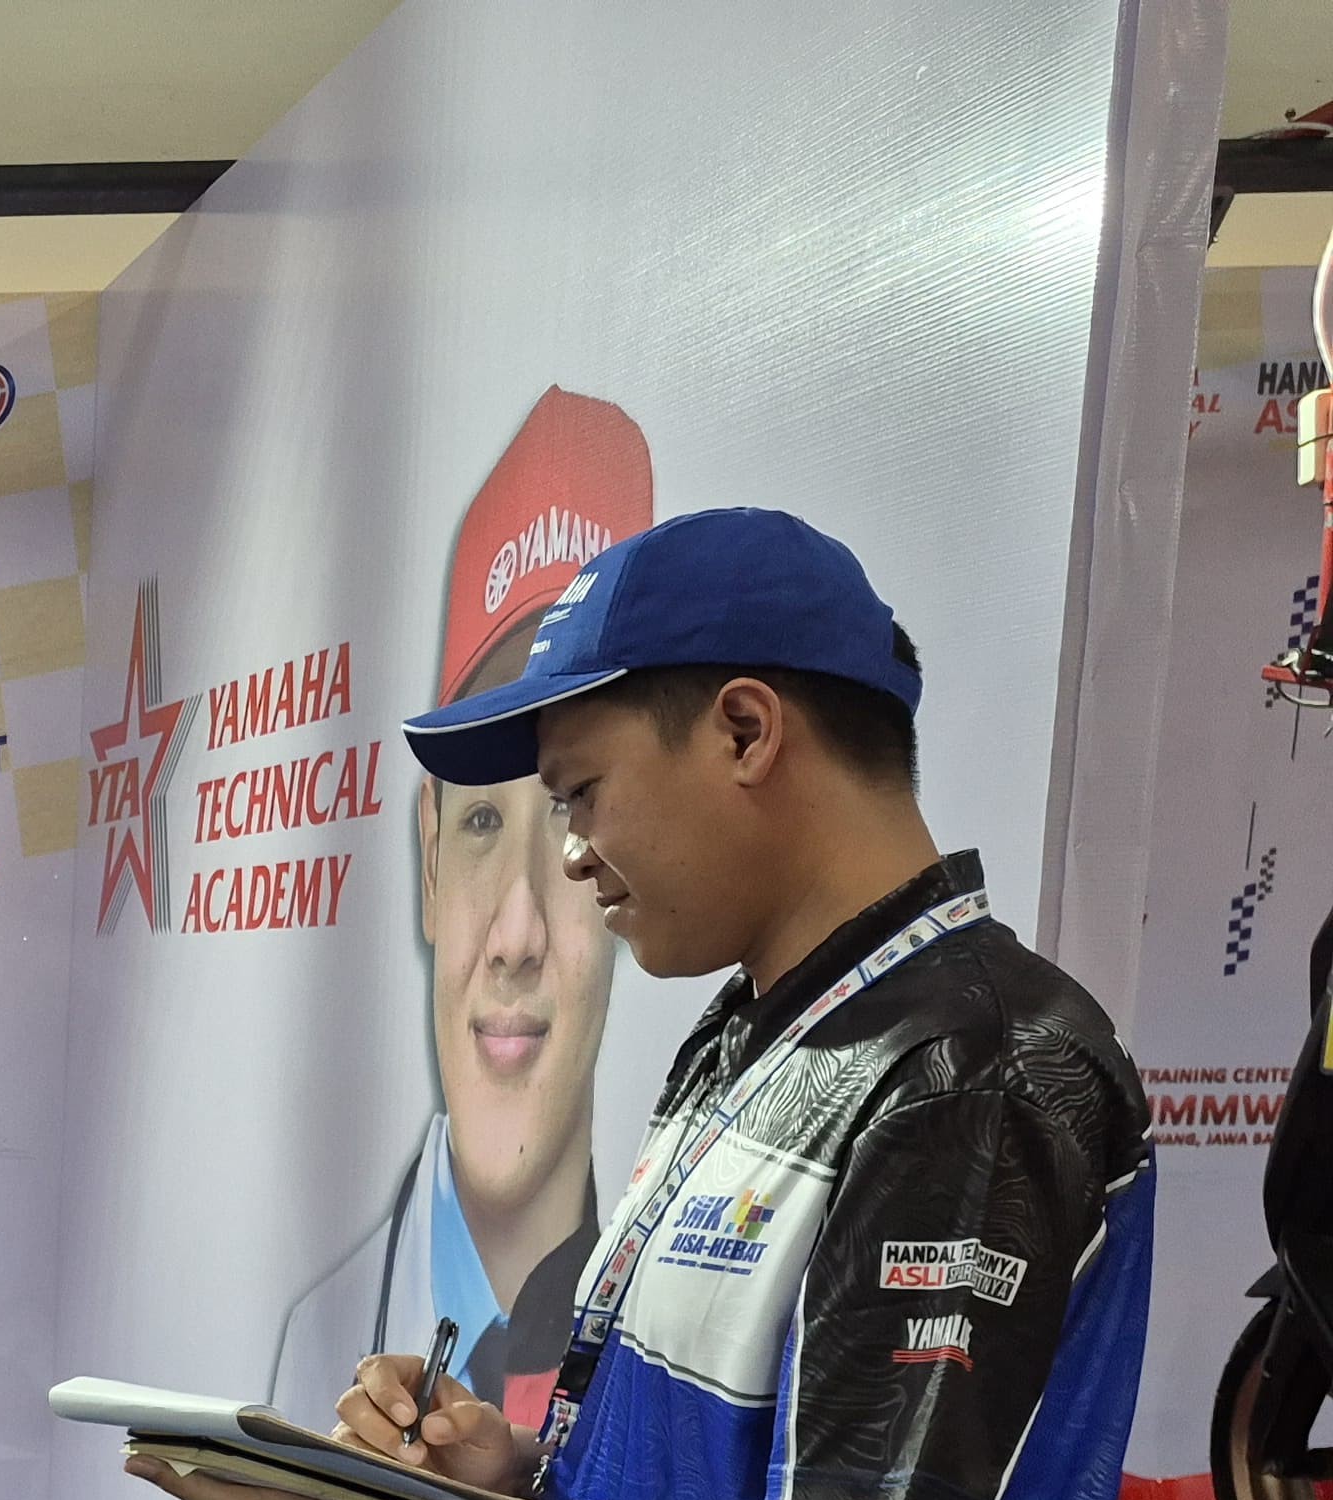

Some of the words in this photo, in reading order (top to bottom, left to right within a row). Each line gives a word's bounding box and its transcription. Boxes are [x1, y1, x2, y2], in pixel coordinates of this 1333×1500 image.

[206, 642, 351, 752] YAMAHA
[89, 753, 140, 828] YTA
[195, 741, 382, 845] TECHNICAL
[182, 854, 352, 936] ACADEMY
[1233, 1067, 1292, 1084] CENTE
[673, 1195, 736, 1231] SMK
[669, 1233, 768, 1263] BISA-HEBAT
[886, 1245, 956, 1263] HANDAL
[885, 1266, 944, 1287] ASLI
